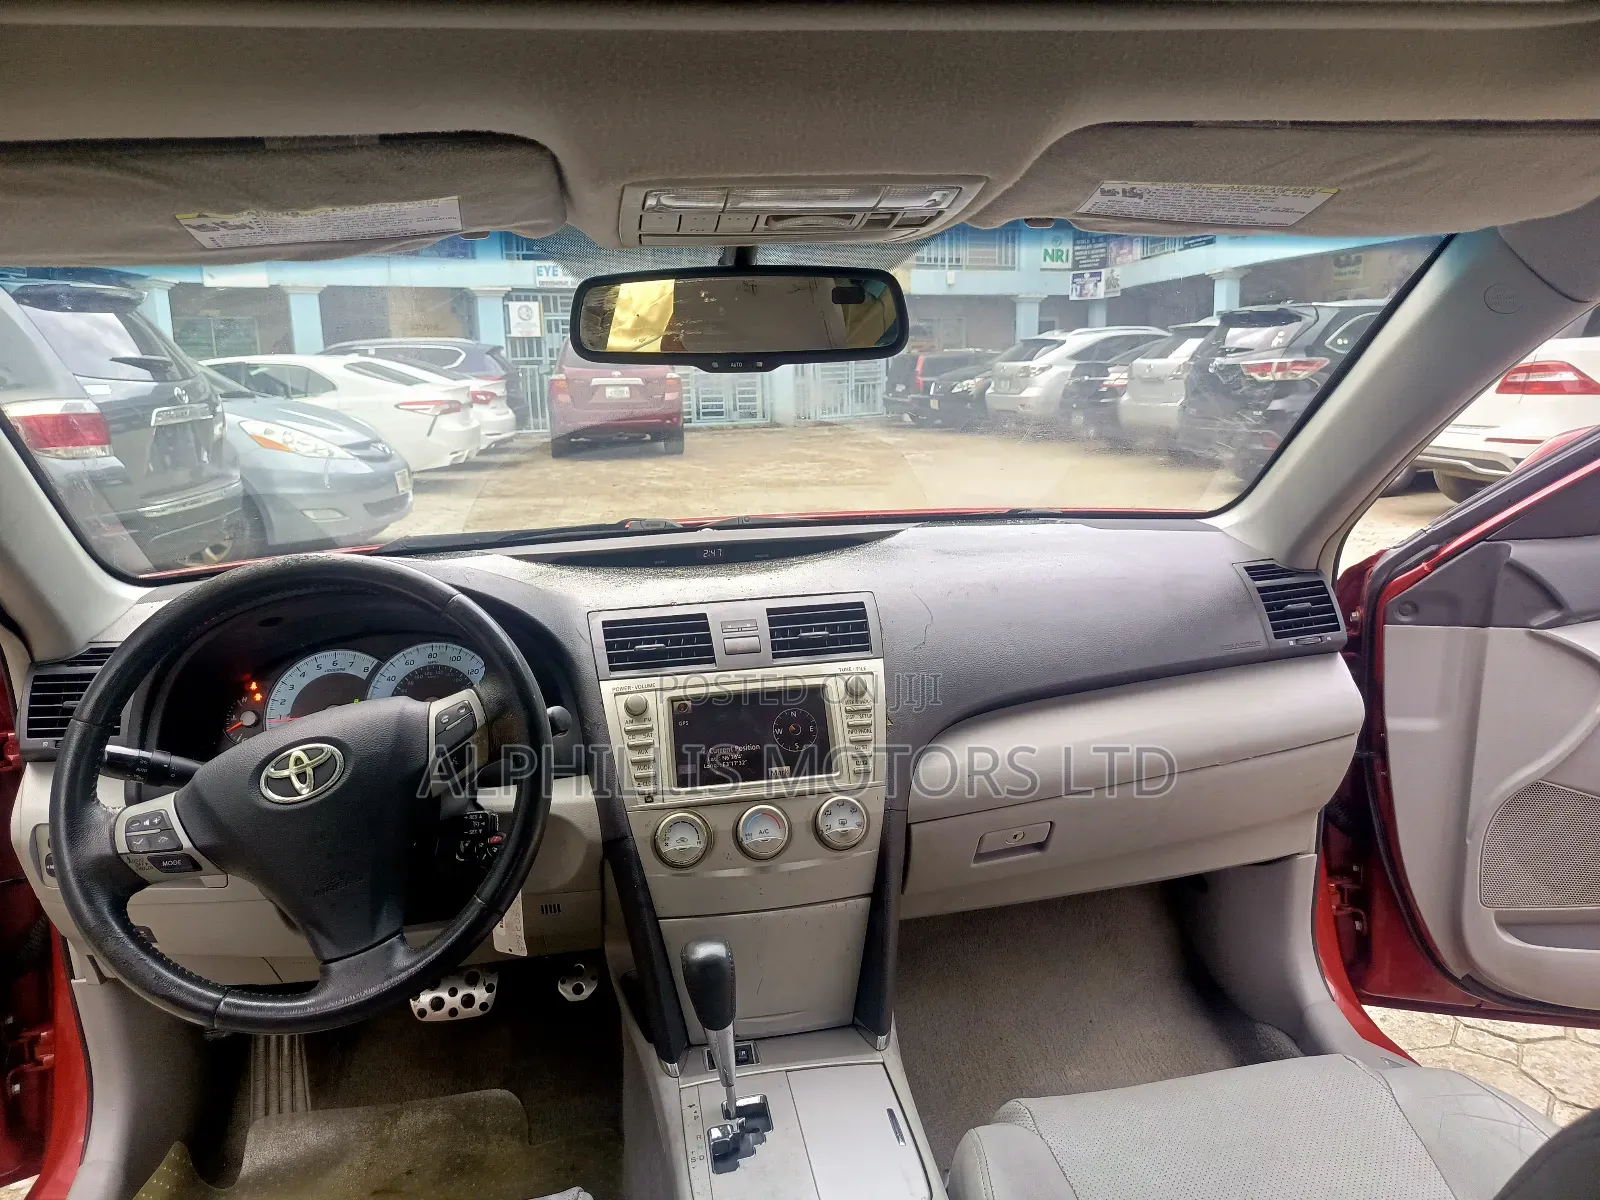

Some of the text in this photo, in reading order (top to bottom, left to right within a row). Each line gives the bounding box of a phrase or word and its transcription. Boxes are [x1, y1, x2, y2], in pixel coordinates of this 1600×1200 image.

[536, 265, 559, 277] EYE
[703, 549, 723, 558] 2:47
[467, 668, 480, 676] 120
[734, 743, 761, 752] Position
[162, 859, 182, 867] MODE
